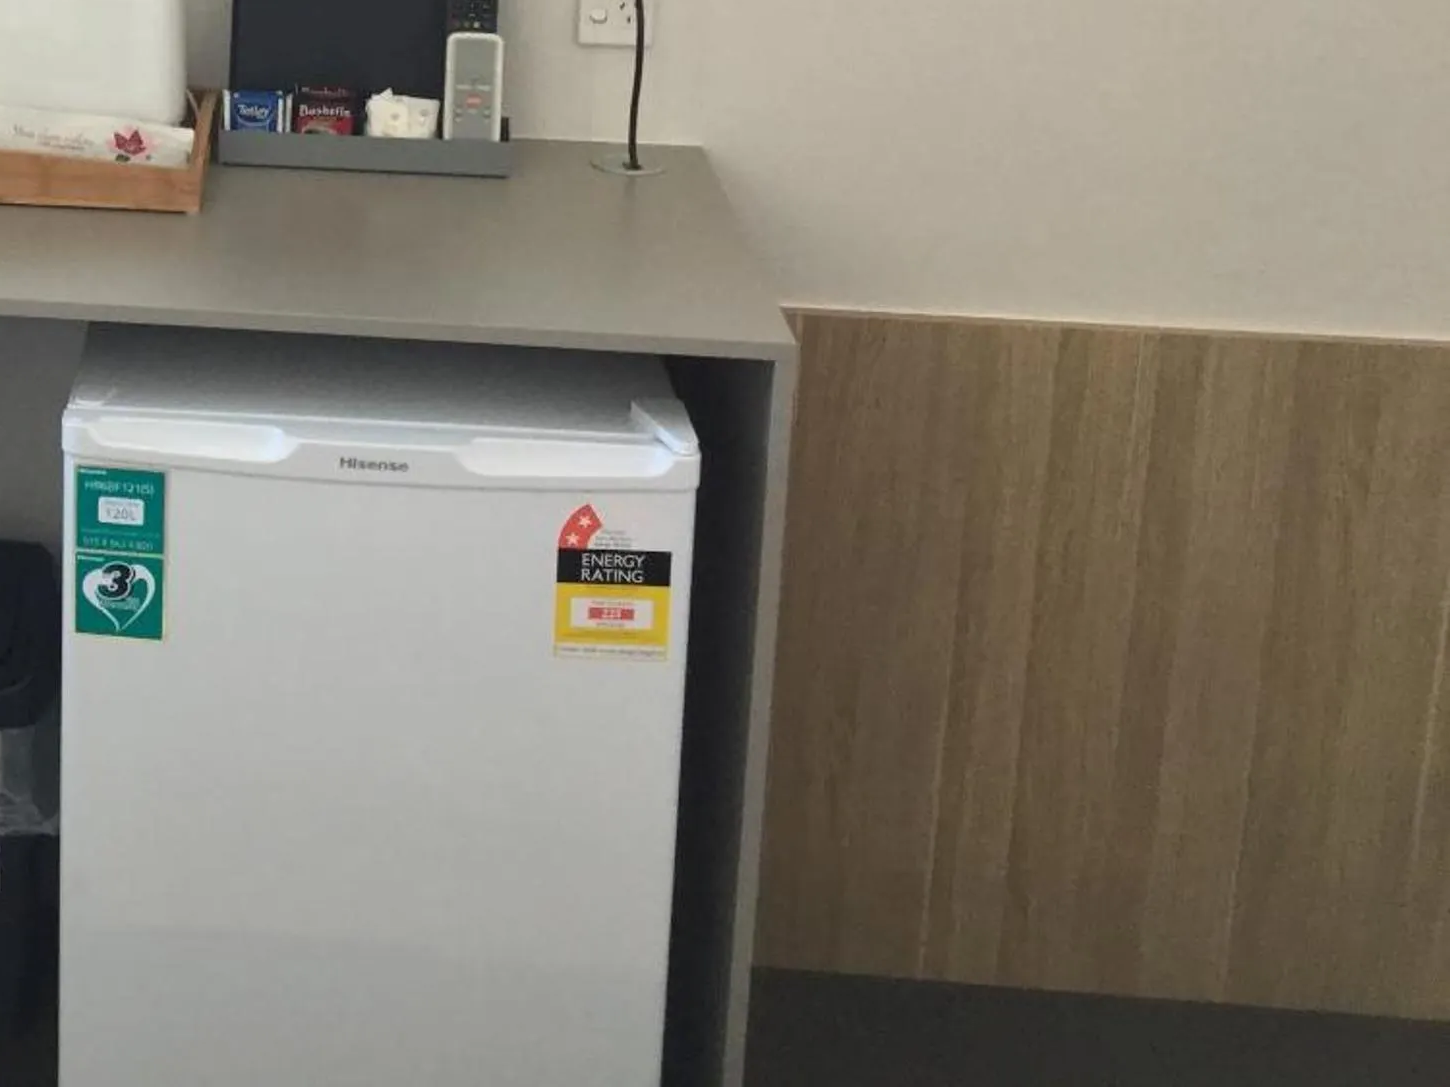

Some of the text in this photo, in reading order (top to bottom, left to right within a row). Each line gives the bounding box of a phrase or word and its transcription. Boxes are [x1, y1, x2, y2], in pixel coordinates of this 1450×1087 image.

[340, 457, 409, 472] Hisense
[581, 553, 646, 568] ENERGY
[97, 562, 132, 599] 3
[581, 568, 644, 583] RATING
